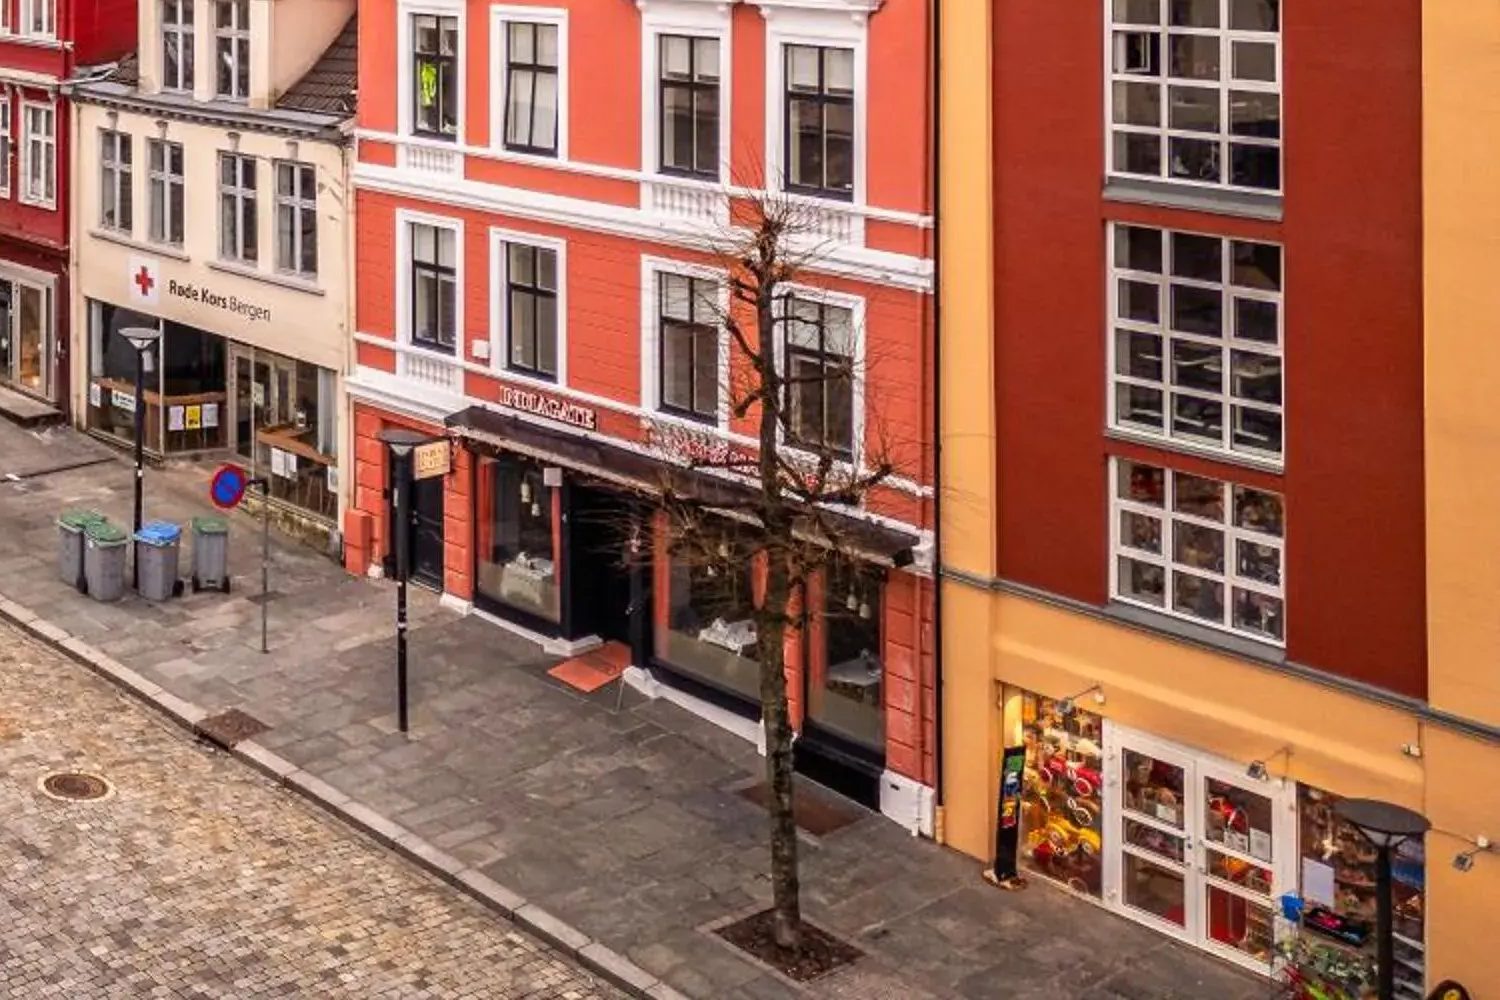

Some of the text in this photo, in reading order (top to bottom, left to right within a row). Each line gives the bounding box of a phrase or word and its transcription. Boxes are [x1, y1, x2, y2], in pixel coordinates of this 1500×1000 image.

[169, 279, 271, 322] Røde Kors Bergen
